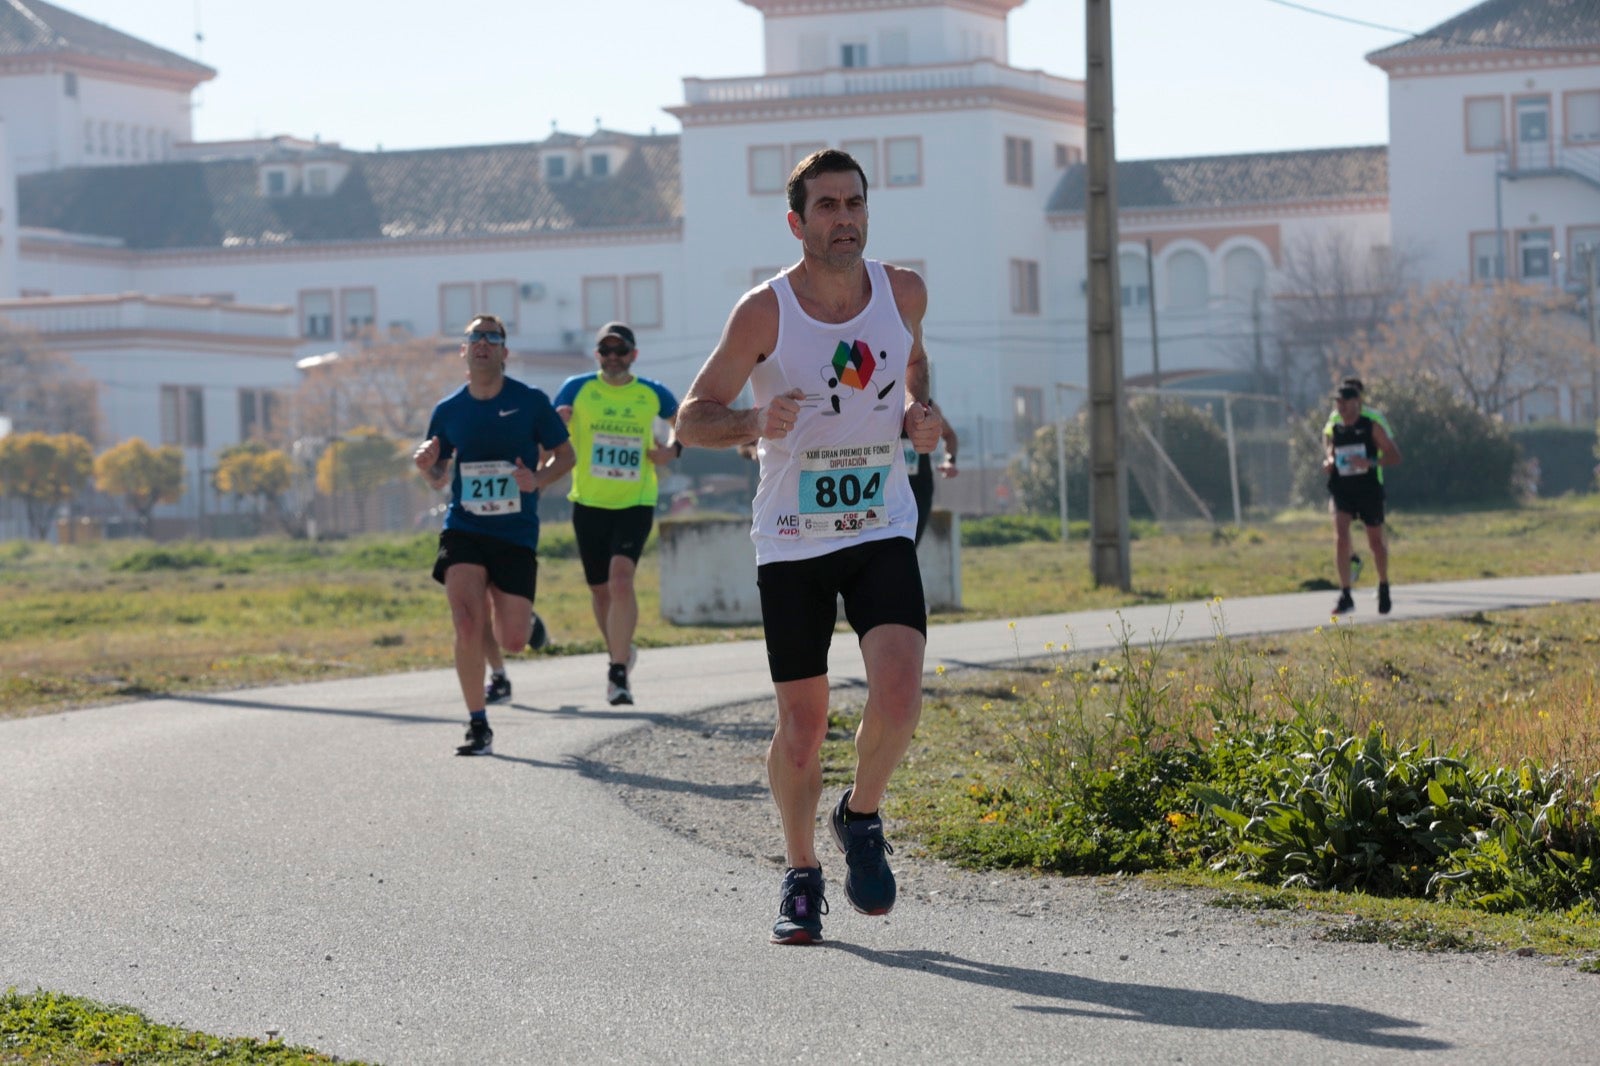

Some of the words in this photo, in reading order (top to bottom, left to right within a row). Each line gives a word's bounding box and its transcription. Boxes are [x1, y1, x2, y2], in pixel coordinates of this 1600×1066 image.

[596, 447, 639, 466] 1106
[821, 448, 838, 459] GRAN
[839, 446, 862, 457] PREMIO
[863, 446, 872, 456] DE
[873, 444, 890, 455] FONDO
[830, 457, 867, 468] DIPUTACIÓN
[472, 478, 508, 497] 217
[815, 472, 880, 507] 804
[776, 515, 799, 526] ME
[779, 527, 799, 536] #ap
